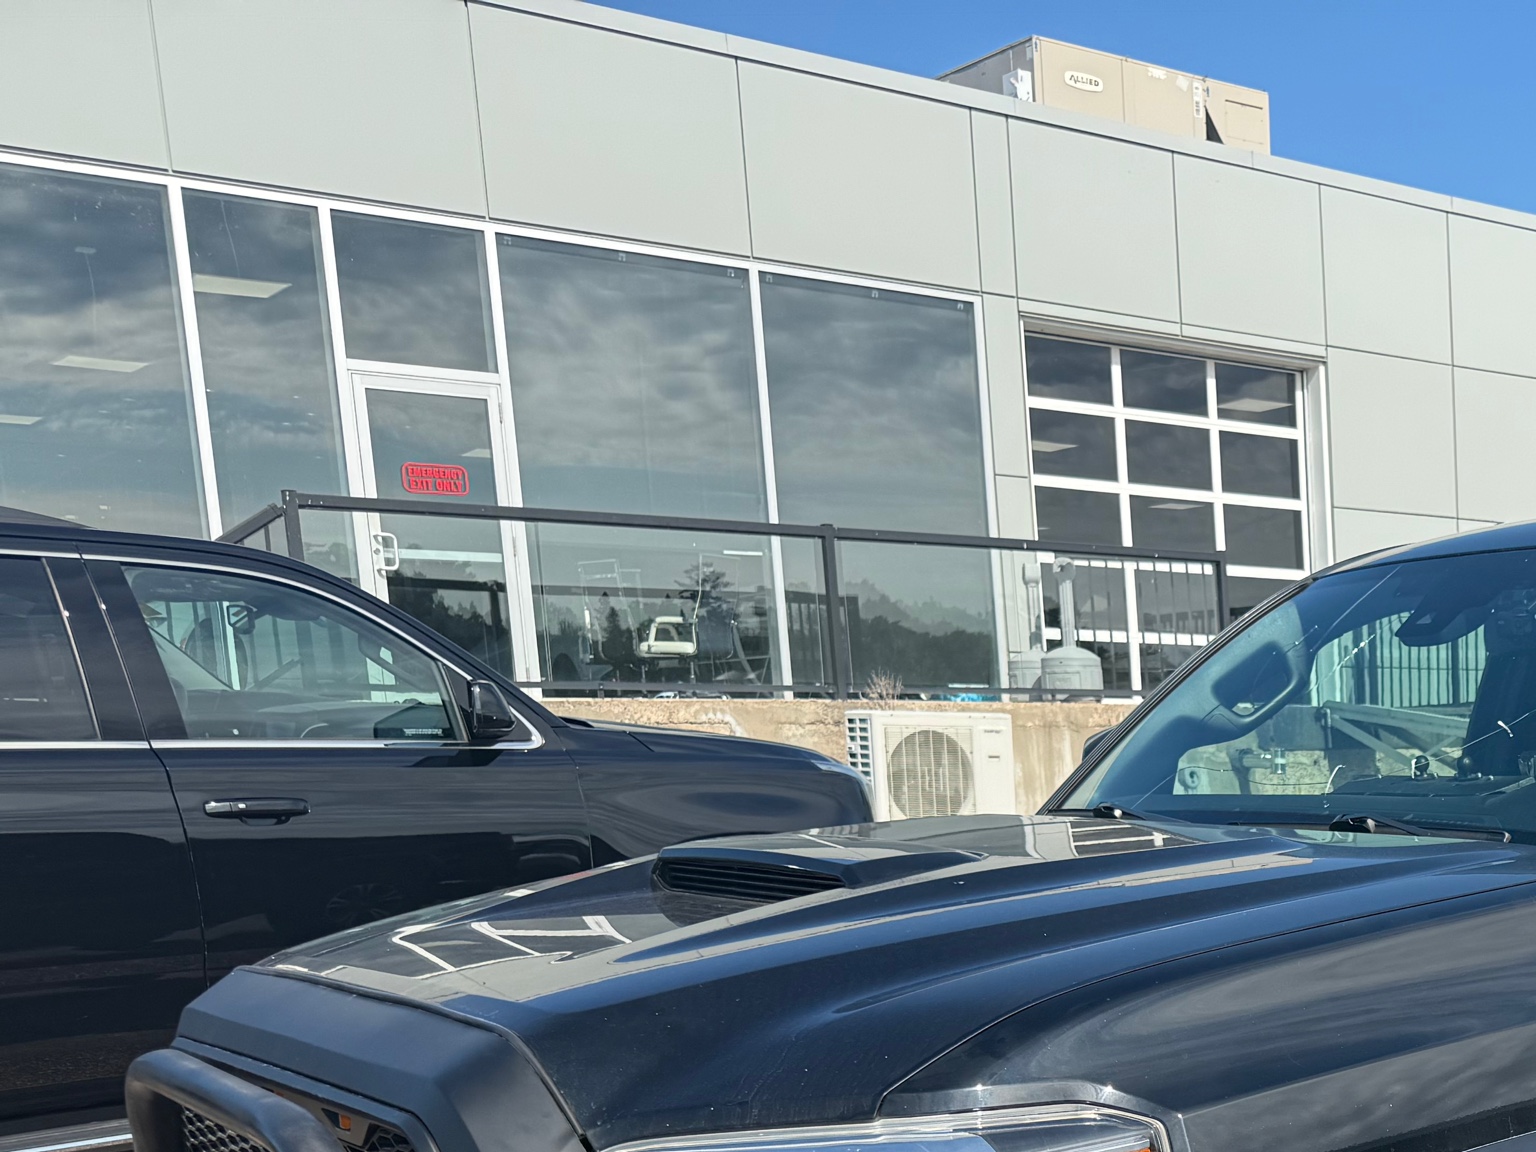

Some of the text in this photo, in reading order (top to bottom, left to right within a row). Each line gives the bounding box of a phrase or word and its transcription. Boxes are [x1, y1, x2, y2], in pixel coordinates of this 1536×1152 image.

[1069, 74, 1100, 87] ALLIED
[407, 467, 463, 480] EMERGENCY
[410, 477, 463, 492] EXIT ONLY
